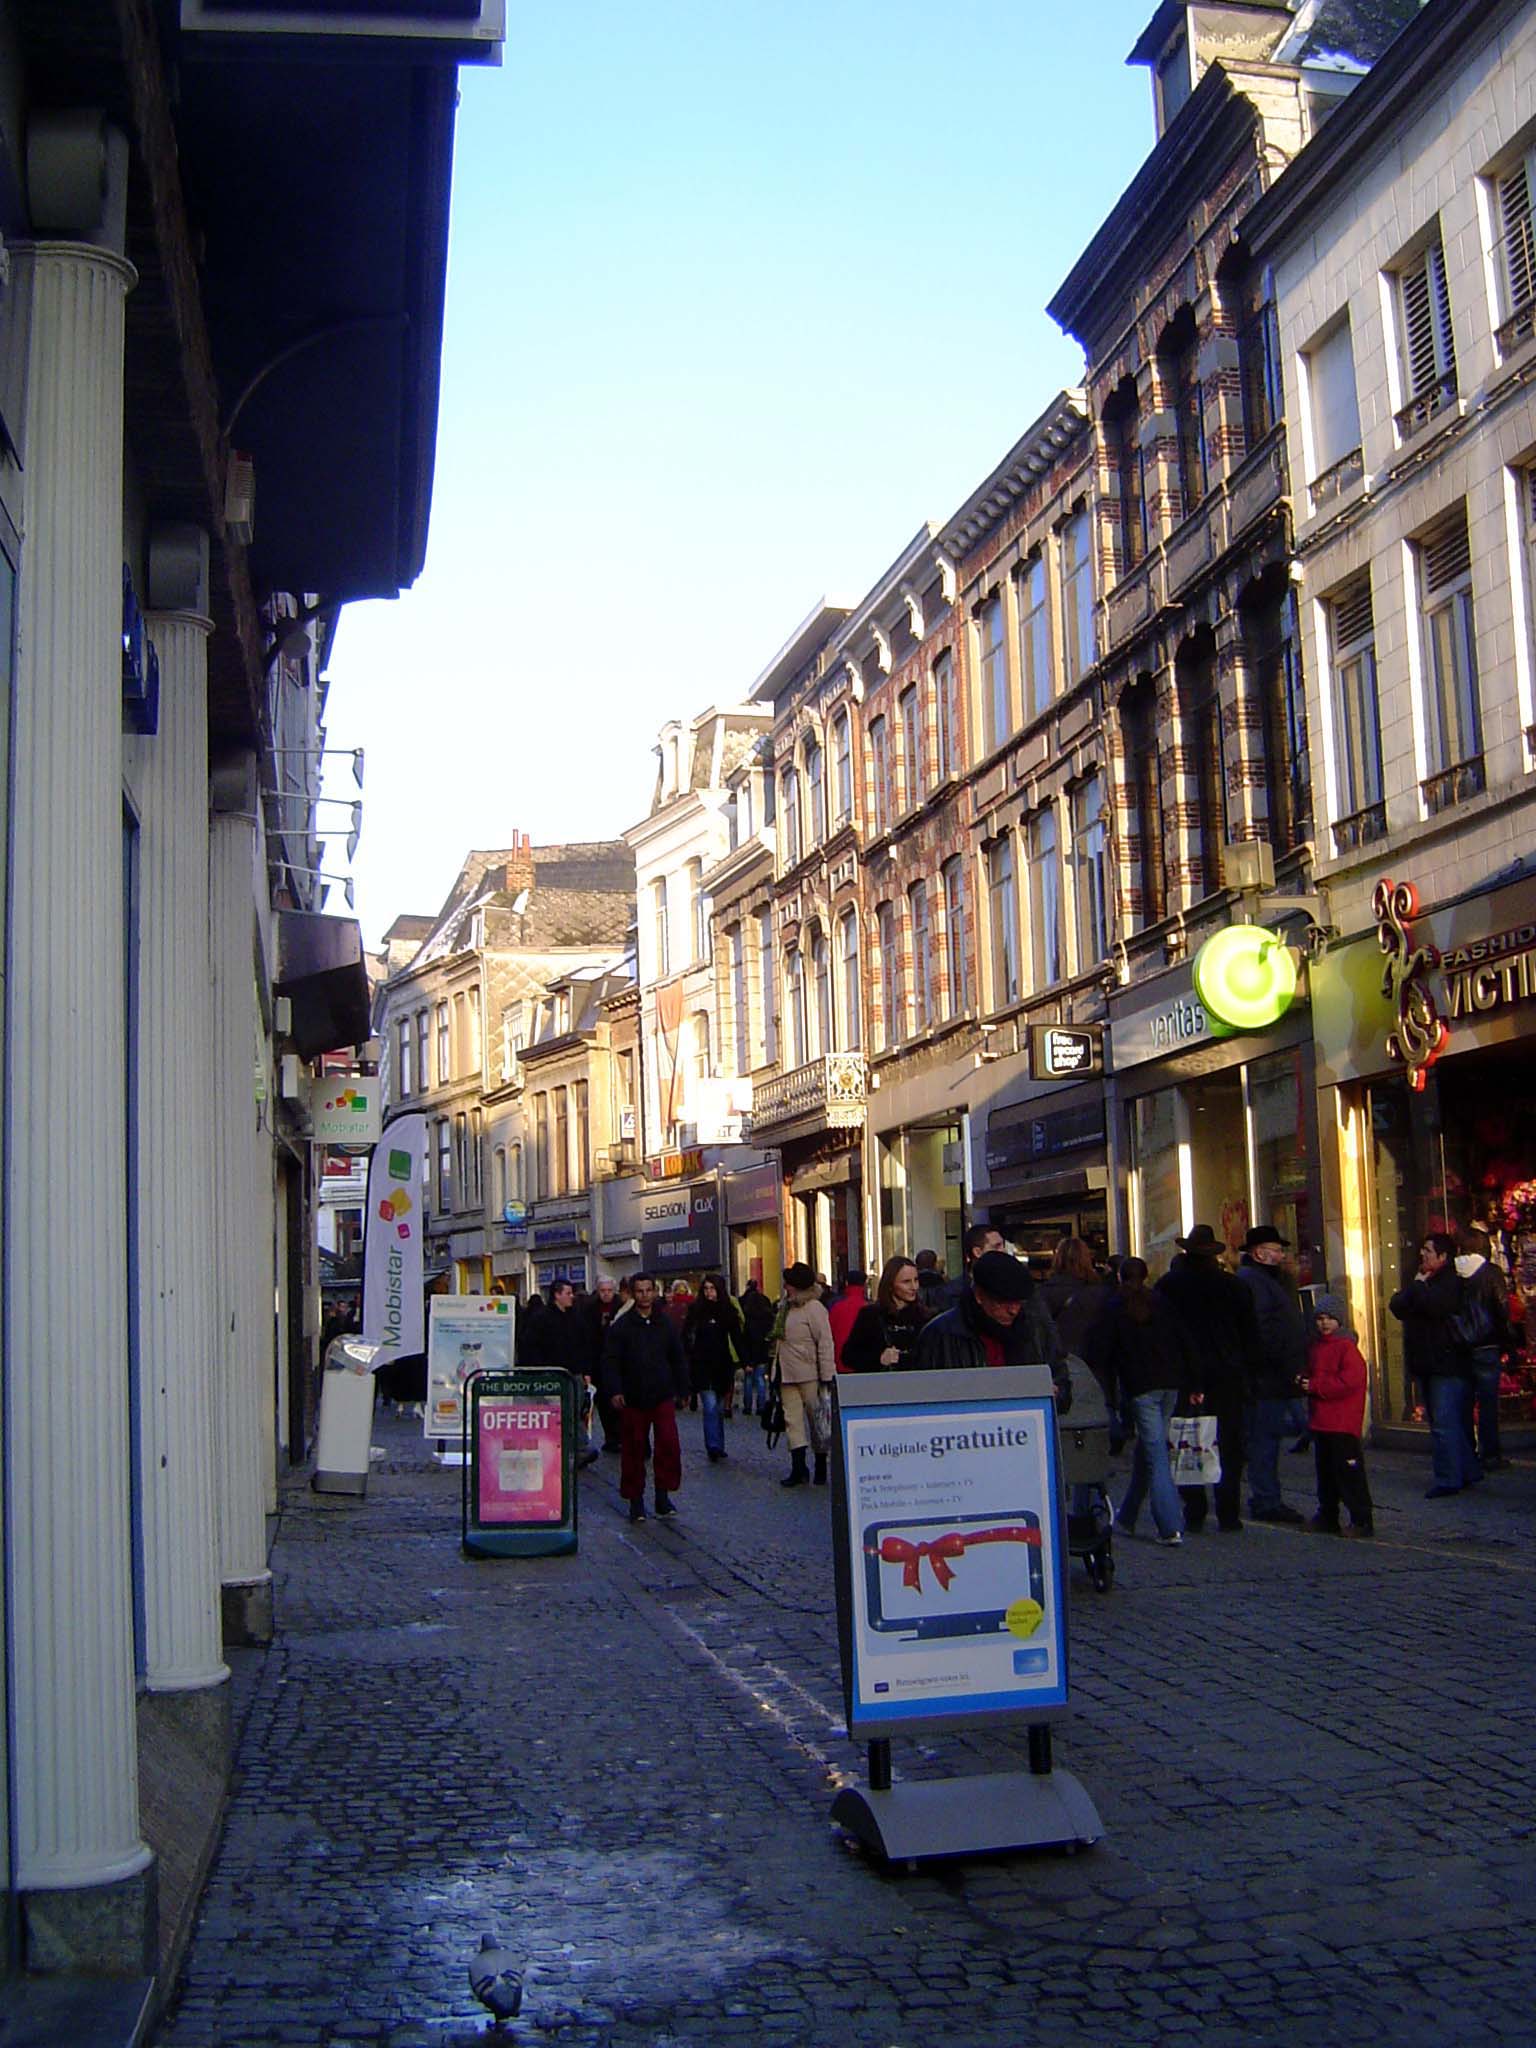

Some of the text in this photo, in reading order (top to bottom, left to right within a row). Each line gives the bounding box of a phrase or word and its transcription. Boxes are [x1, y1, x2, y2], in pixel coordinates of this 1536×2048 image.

[1150, 1000, 1206, 1048] veritas
[1052, 1032, 1073, 1046] free
[1053, 1044, 1084, 1056] record
[320, 1121, 369, 1133] Mobistar
[382, 1245, 403, 1348] Mobistar
[480, 1381, 561, 1392] THE BODY SHOP
[857, 1426, 1028, 1459] TV digitale gratuite
